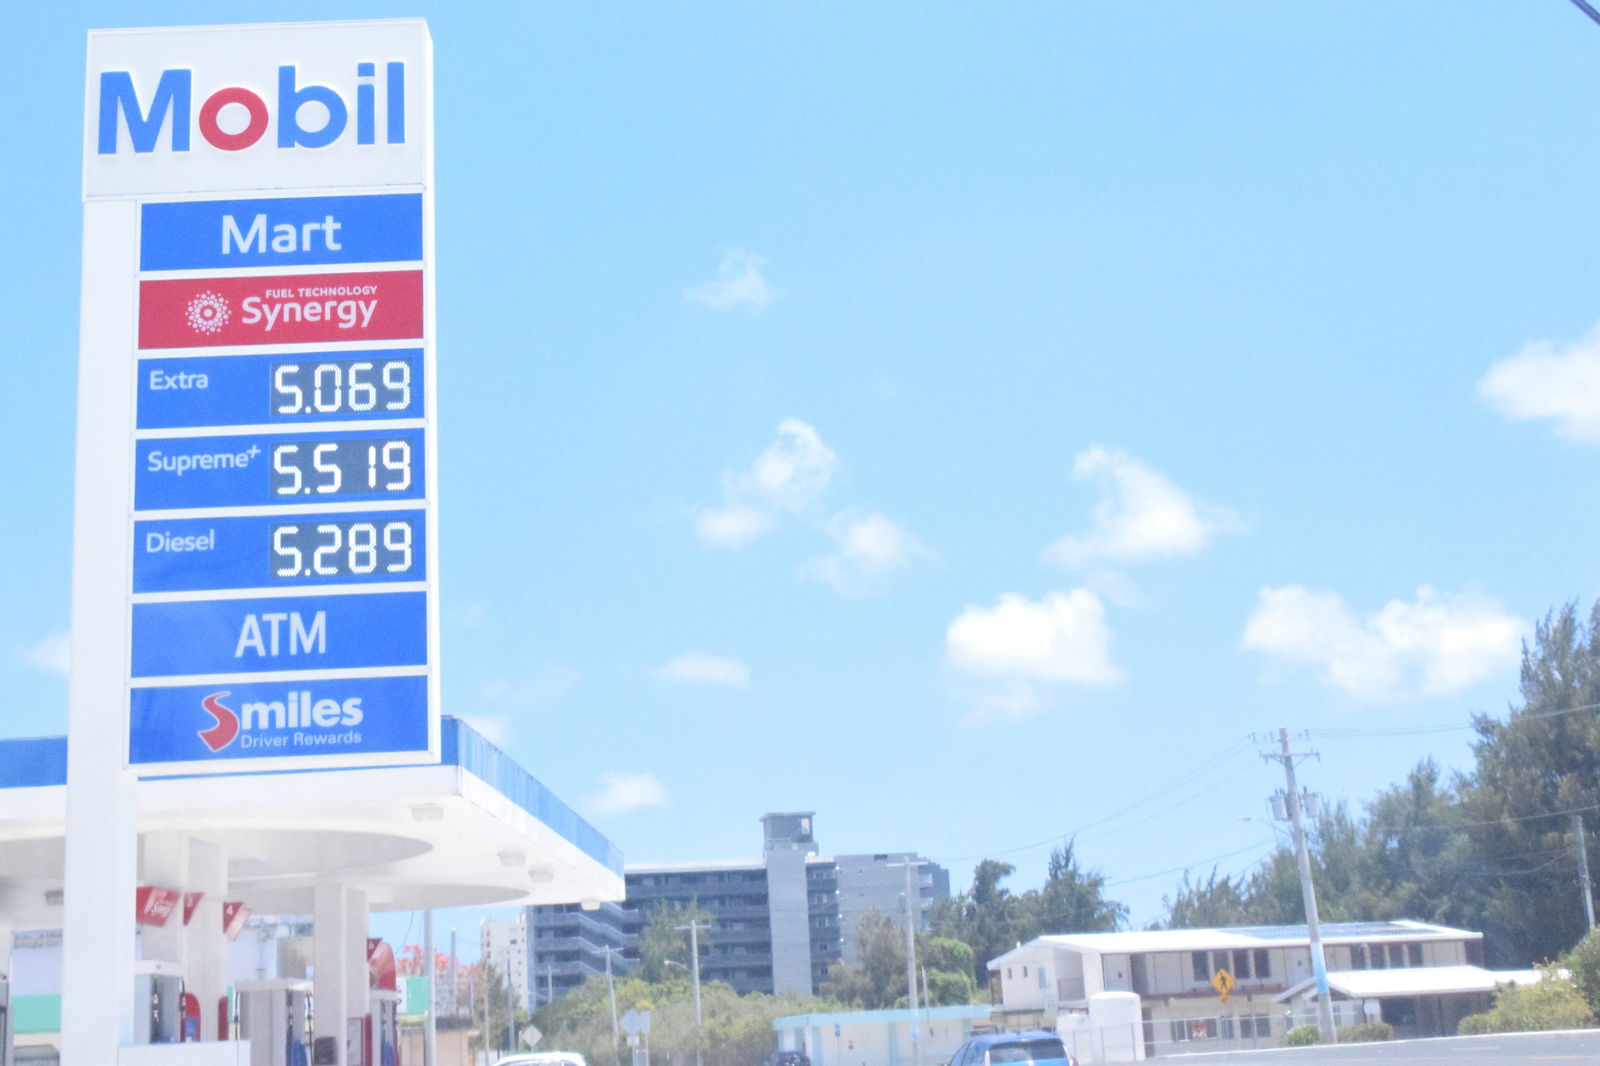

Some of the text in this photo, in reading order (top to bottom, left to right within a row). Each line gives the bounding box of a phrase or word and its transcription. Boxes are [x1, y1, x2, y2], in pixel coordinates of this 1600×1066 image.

[98, 61, 406, 155] Mobil
[221, 213, 342, 254] Mart
[241, 296, 378, 332] Synergy
[265, 286, 378, 299] FUEL TECHNOLOGY
[149, 361, 412, 415] Extra 5.069
[273, 440, 412, 495] 5.519
[146, 521, 412, 577] Diesel 5.289
[234, 610, 326, 658] ATM
[197, 690, 364, 753] Smiles
[241, 730, 363, 749] Driver Rewards
